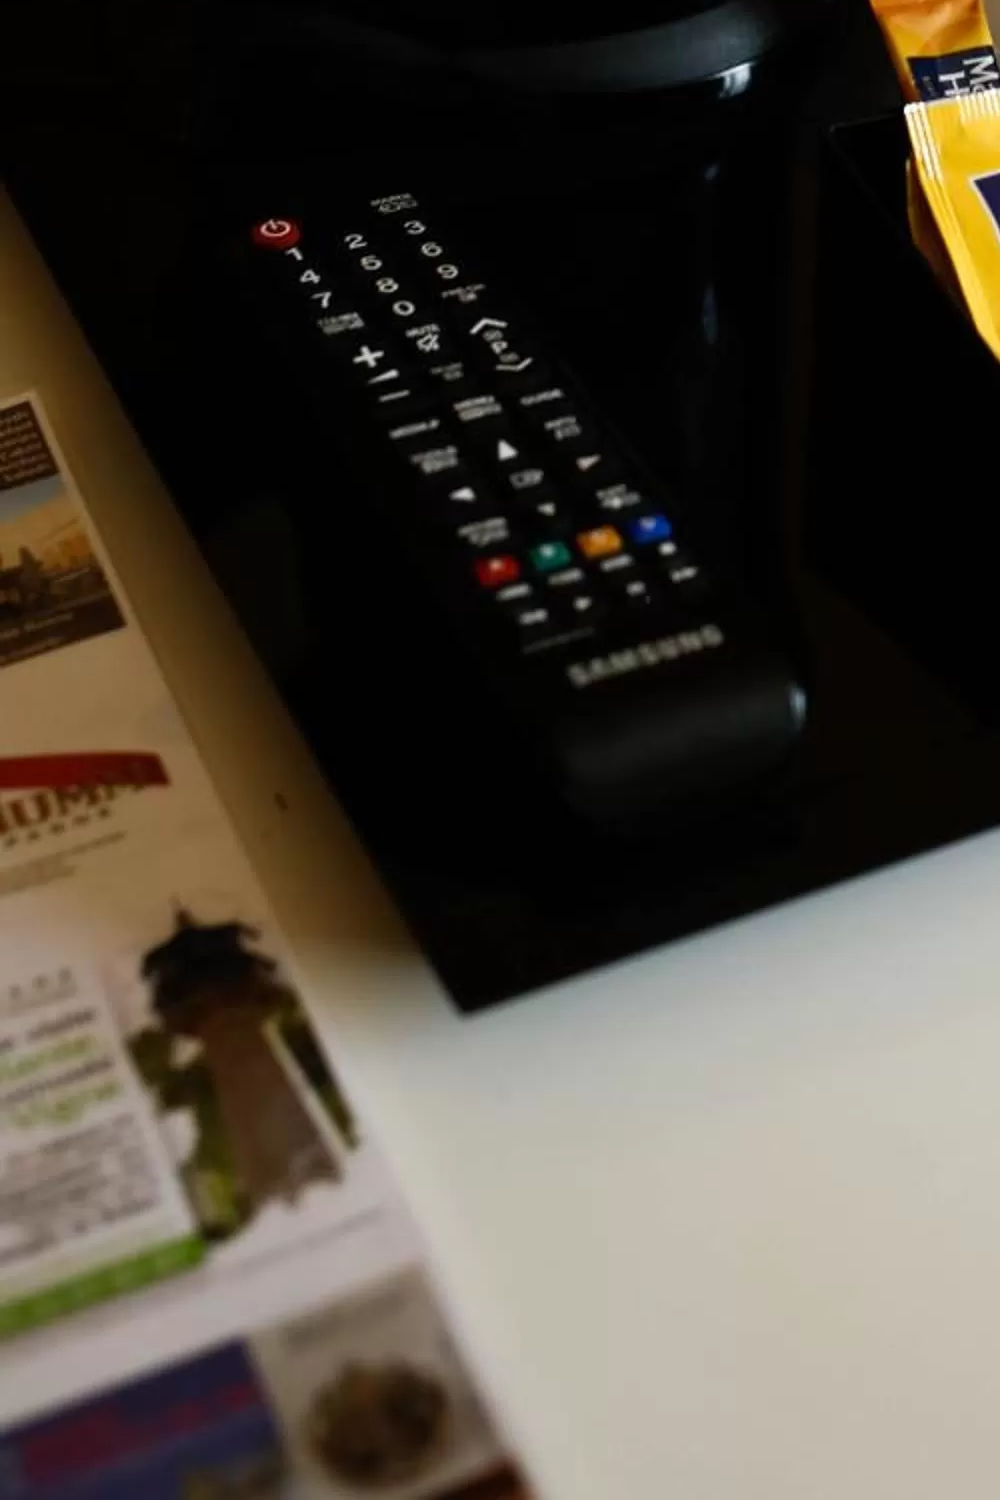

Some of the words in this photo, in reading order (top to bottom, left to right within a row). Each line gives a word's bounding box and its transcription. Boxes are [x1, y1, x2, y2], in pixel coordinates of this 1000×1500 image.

[285, 246, 304, 261] 1
[343, 233, 368, 250] 2
[403, 219, 427, 236] 3
[299, 268, 321, 285] 4
[420, 241, 444, 257] 6
[311, 290, 333, 309] 7
[375, 277, 399, 294] 8
[436, 263, 459, 280] 9
[392, 300, 416, 316] 0
[567, 624, 724, 688] SAMSUNG
